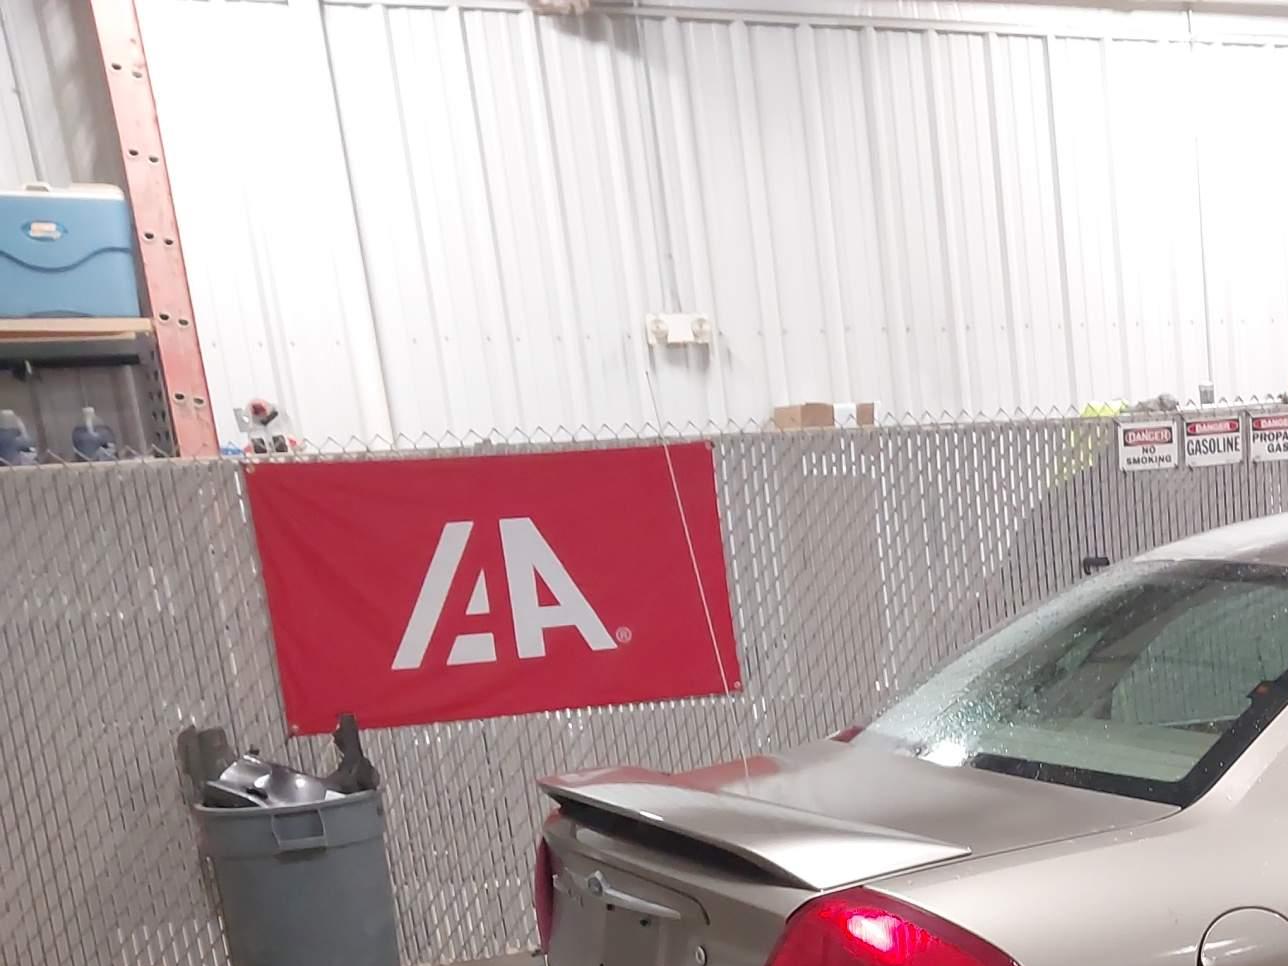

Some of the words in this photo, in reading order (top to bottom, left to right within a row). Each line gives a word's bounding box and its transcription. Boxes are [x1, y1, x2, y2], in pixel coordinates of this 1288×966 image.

[1127, 430, 1169, 443] DANGER
[1142, 445, 1156, 454] NO
[1187, 436, 1240, 456] GASOLINE
[1267, 442, 1288, 453] GAS
[1126, 455, 1172, 465] SMOKING
